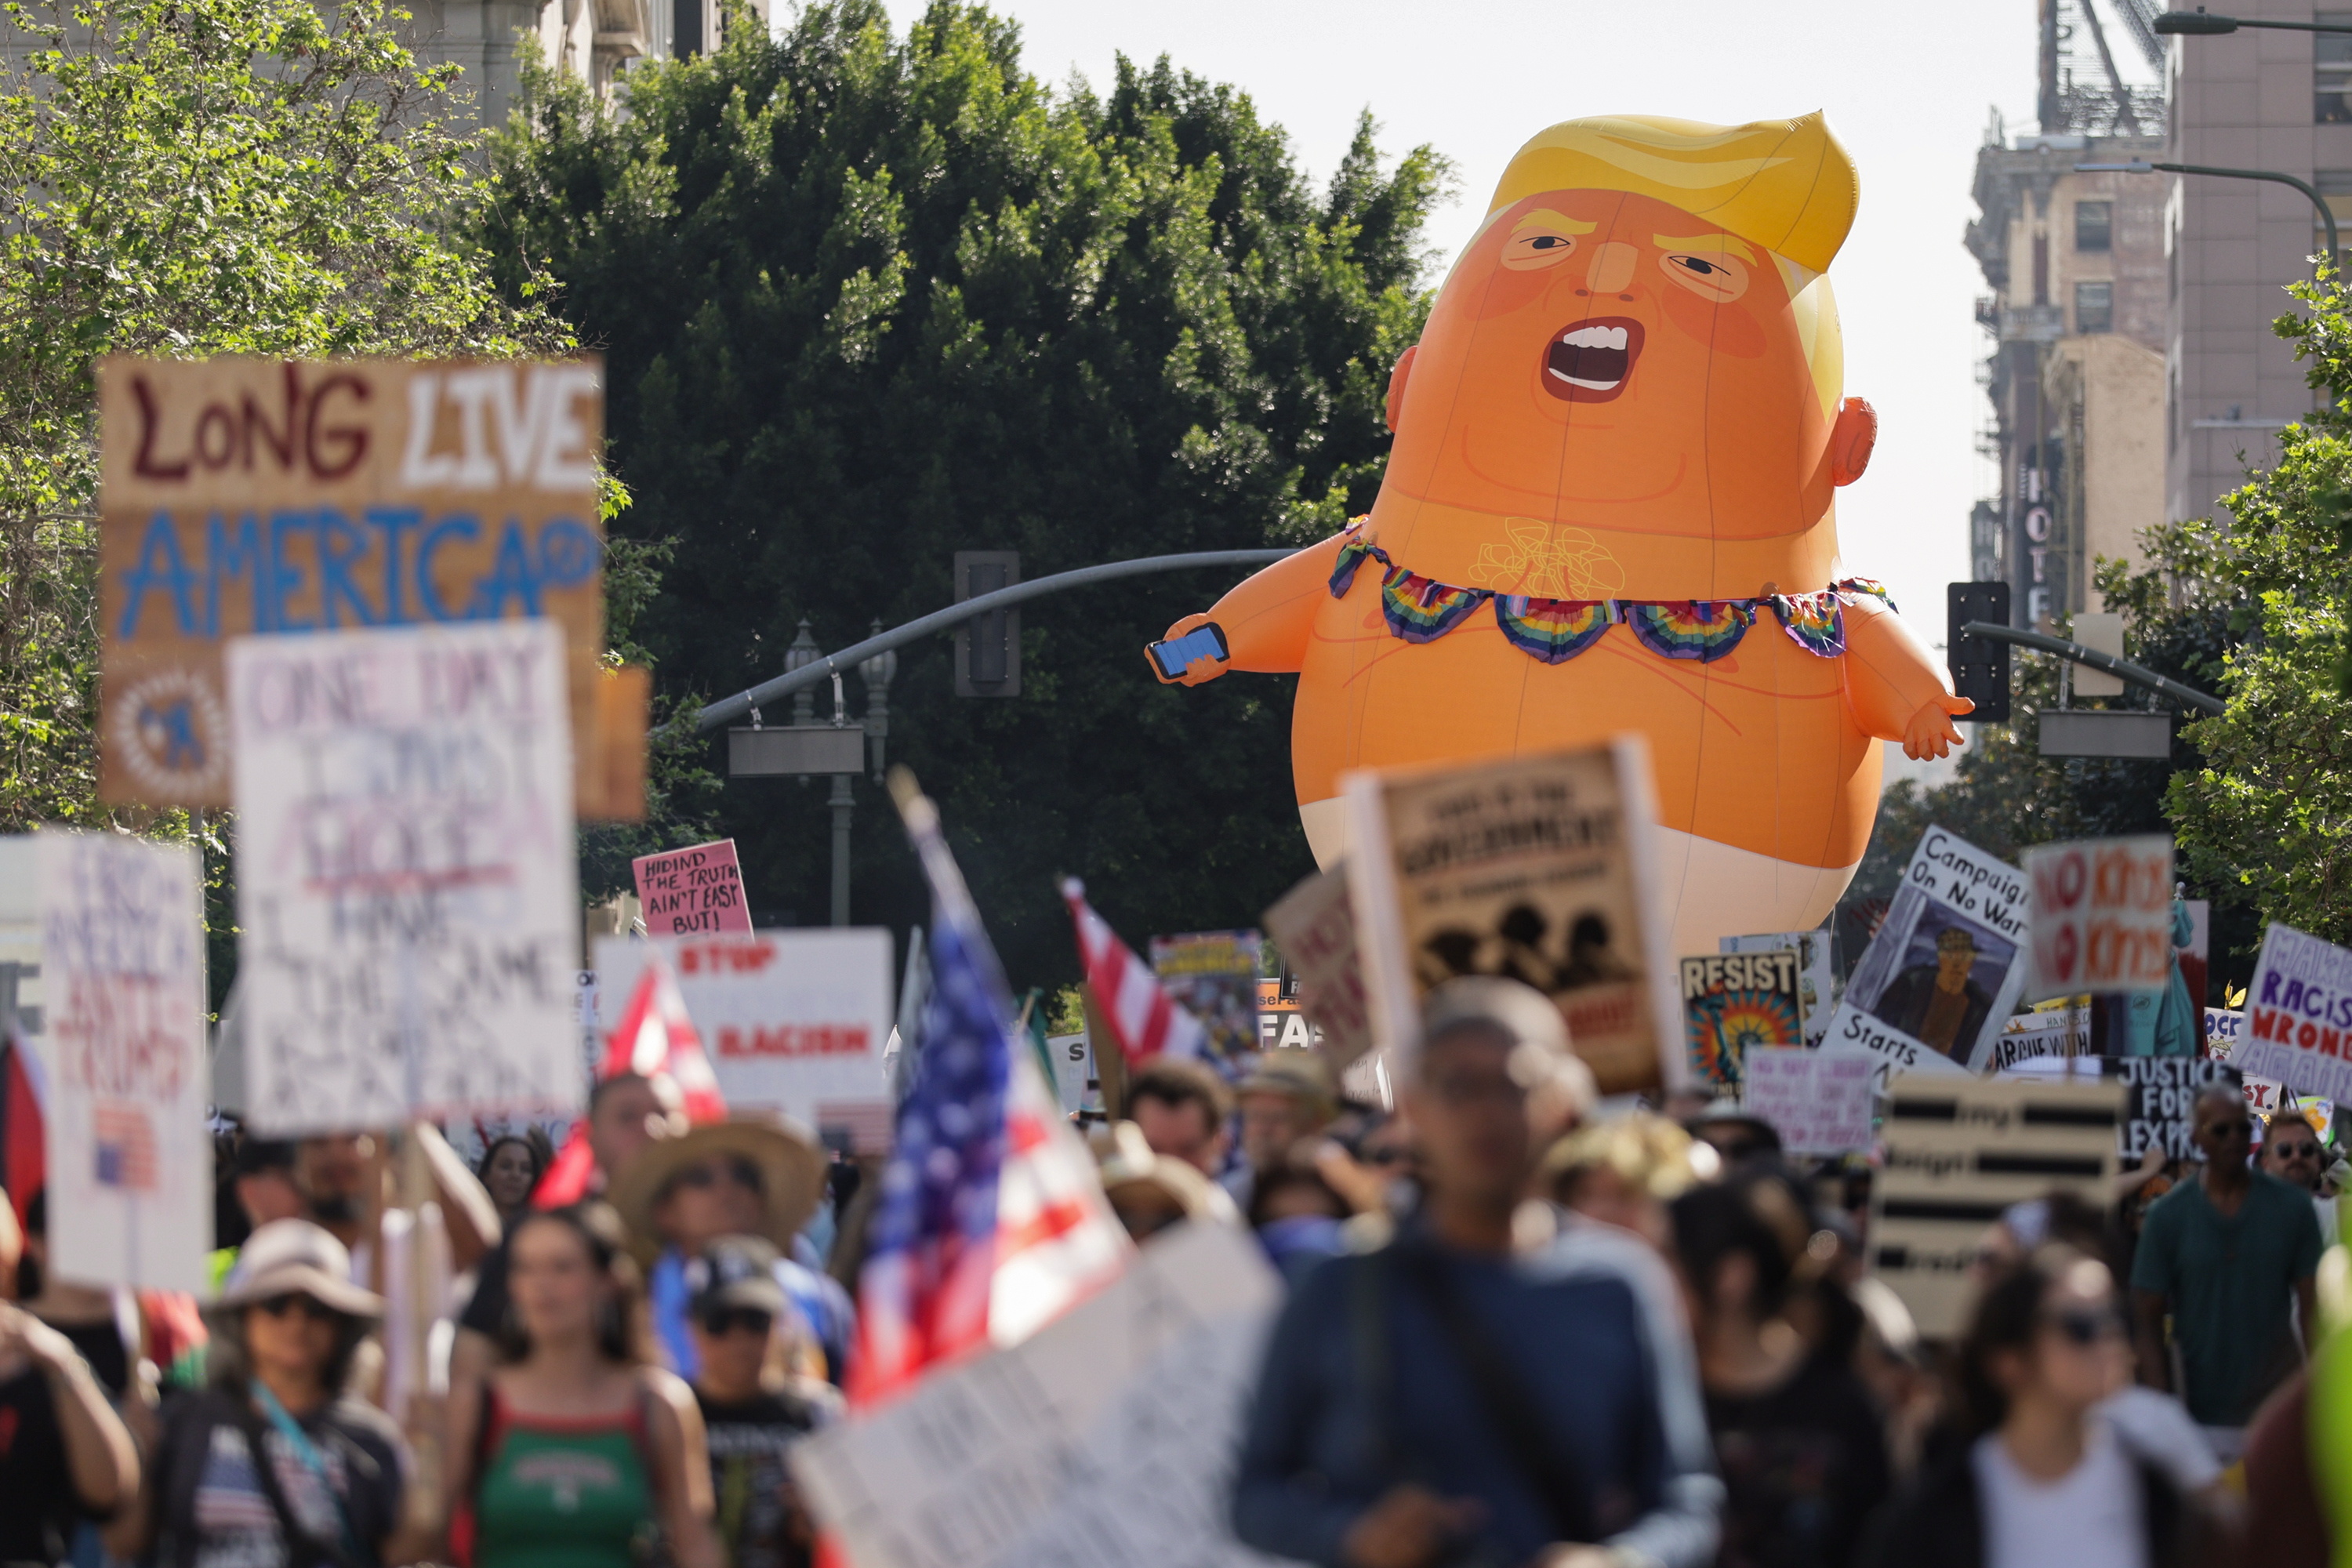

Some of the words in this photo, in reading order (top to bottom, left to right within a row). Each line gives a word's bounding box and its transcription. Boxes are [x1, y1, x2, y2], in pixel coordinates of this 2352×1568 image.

[401, 368, 601, 490] LIVE
[2025, 468, 2053, 633] HOTE
[118, 505, 544, 641] AMERICA
[643, 873, 681, 890] THE
[687, 864, 739, 887] TRUTH
[650, 889, 697, 915] AIN'T
[703, 884, 738, 909] EASY
[1912, 861, 1936, 888] On
[1947, 881, 1976, 910] No
[1984, 897, 2029, 935] War
[673, 910, 720, 935] BUT!
[679, 940, 778, 975] STOP
[1682, 954, 1795, 1000] RESIST
[718, 1022, 871, 1058] RACISM
[1844, 1014, 1918, 1066] Starts
[2049, 1031, 2091, 1060] WITH
[2118, 1058, 2228, 1087] JUSTICE
